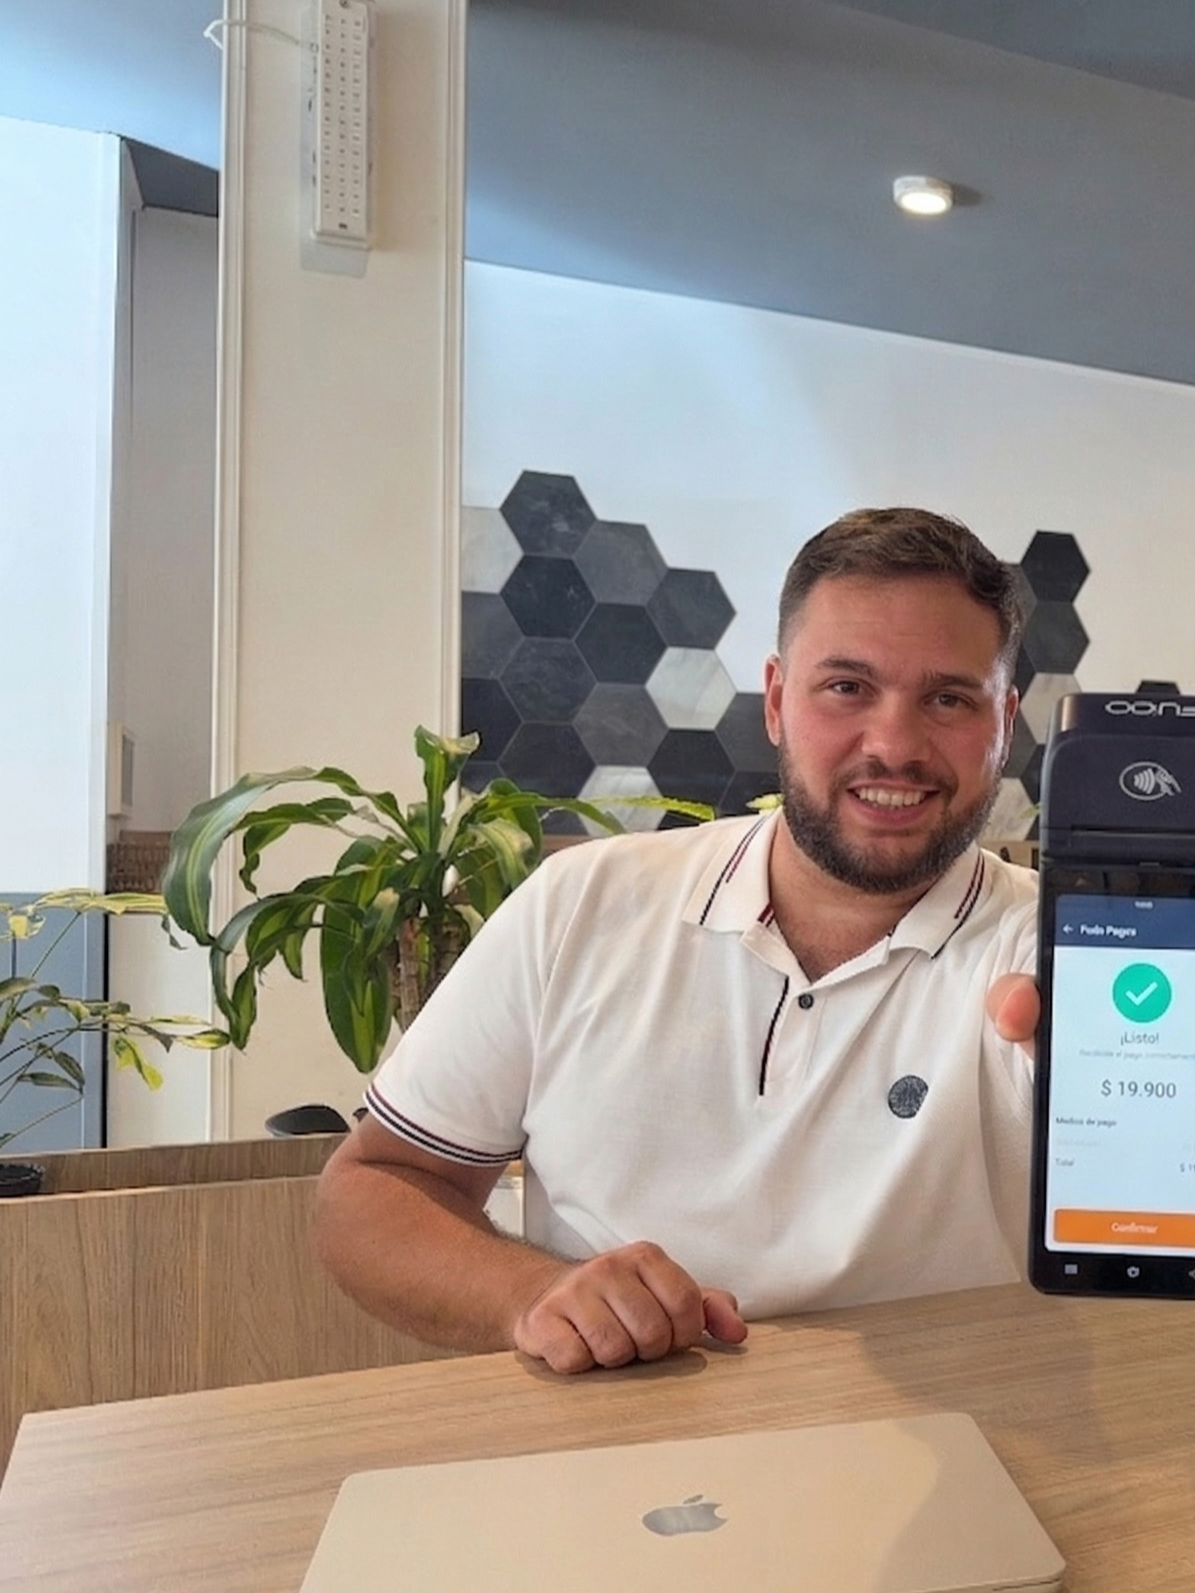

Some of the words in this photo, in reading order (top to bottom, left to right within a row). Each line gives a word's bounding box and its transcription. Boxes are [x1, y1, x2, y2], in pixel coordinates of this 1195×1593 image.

[1120, 1031, 1160, 1046] ¡Listo!
[1101, 1078, 1113, 1098] $
[1117, 1080, 1177, 1099] 19.900
